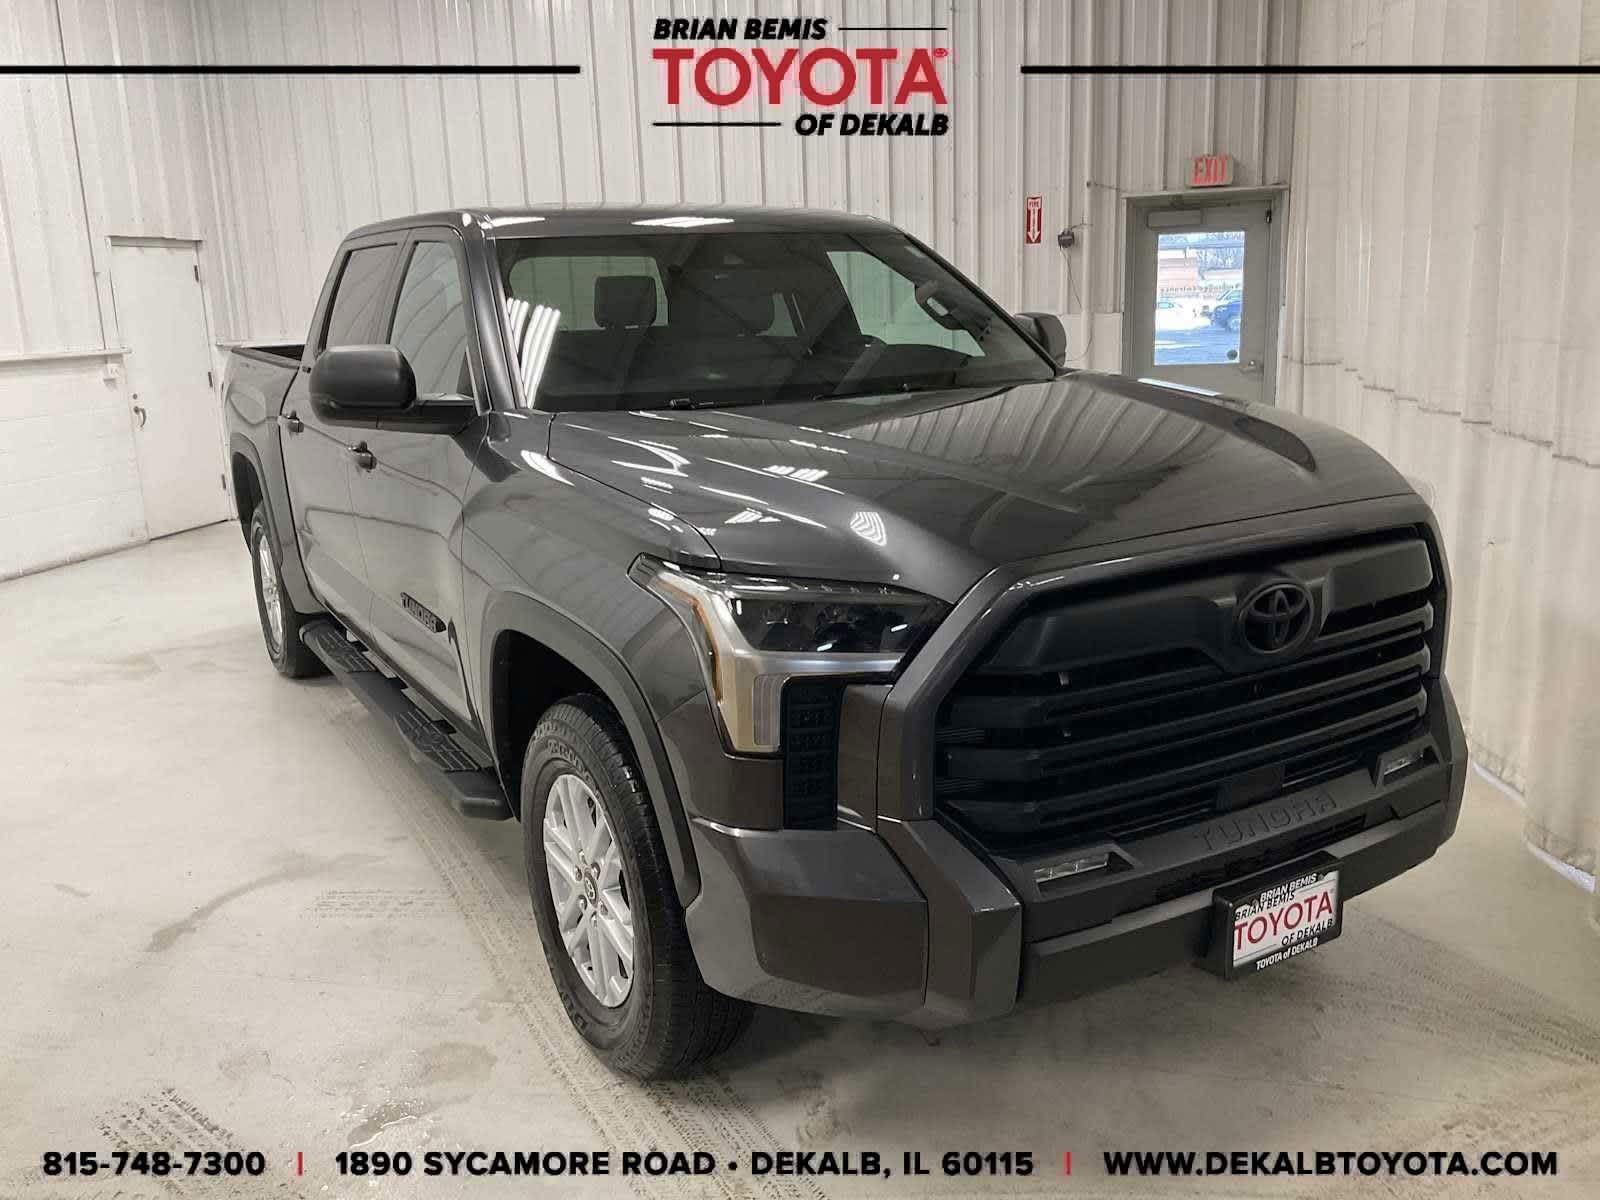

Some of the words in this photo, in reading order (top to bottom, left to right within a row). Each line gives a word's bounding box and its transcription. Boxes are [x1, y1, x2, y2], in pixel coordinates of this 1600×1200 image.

[1192, 156, 1228, 184] EXIT
[1260, 884, 1289, 903] BRIAN
[1289, 873, 1317, 892] BEMIS
[1234, 891, 1333, 950] TOYOTA
[1281, 934, 1295, 946] OF
[1296, 918, 1333, 941] DEKALB
[1256, 952, 1282, 971] TOYOTA
[1291, 937, 1318, 956] DEKALB
